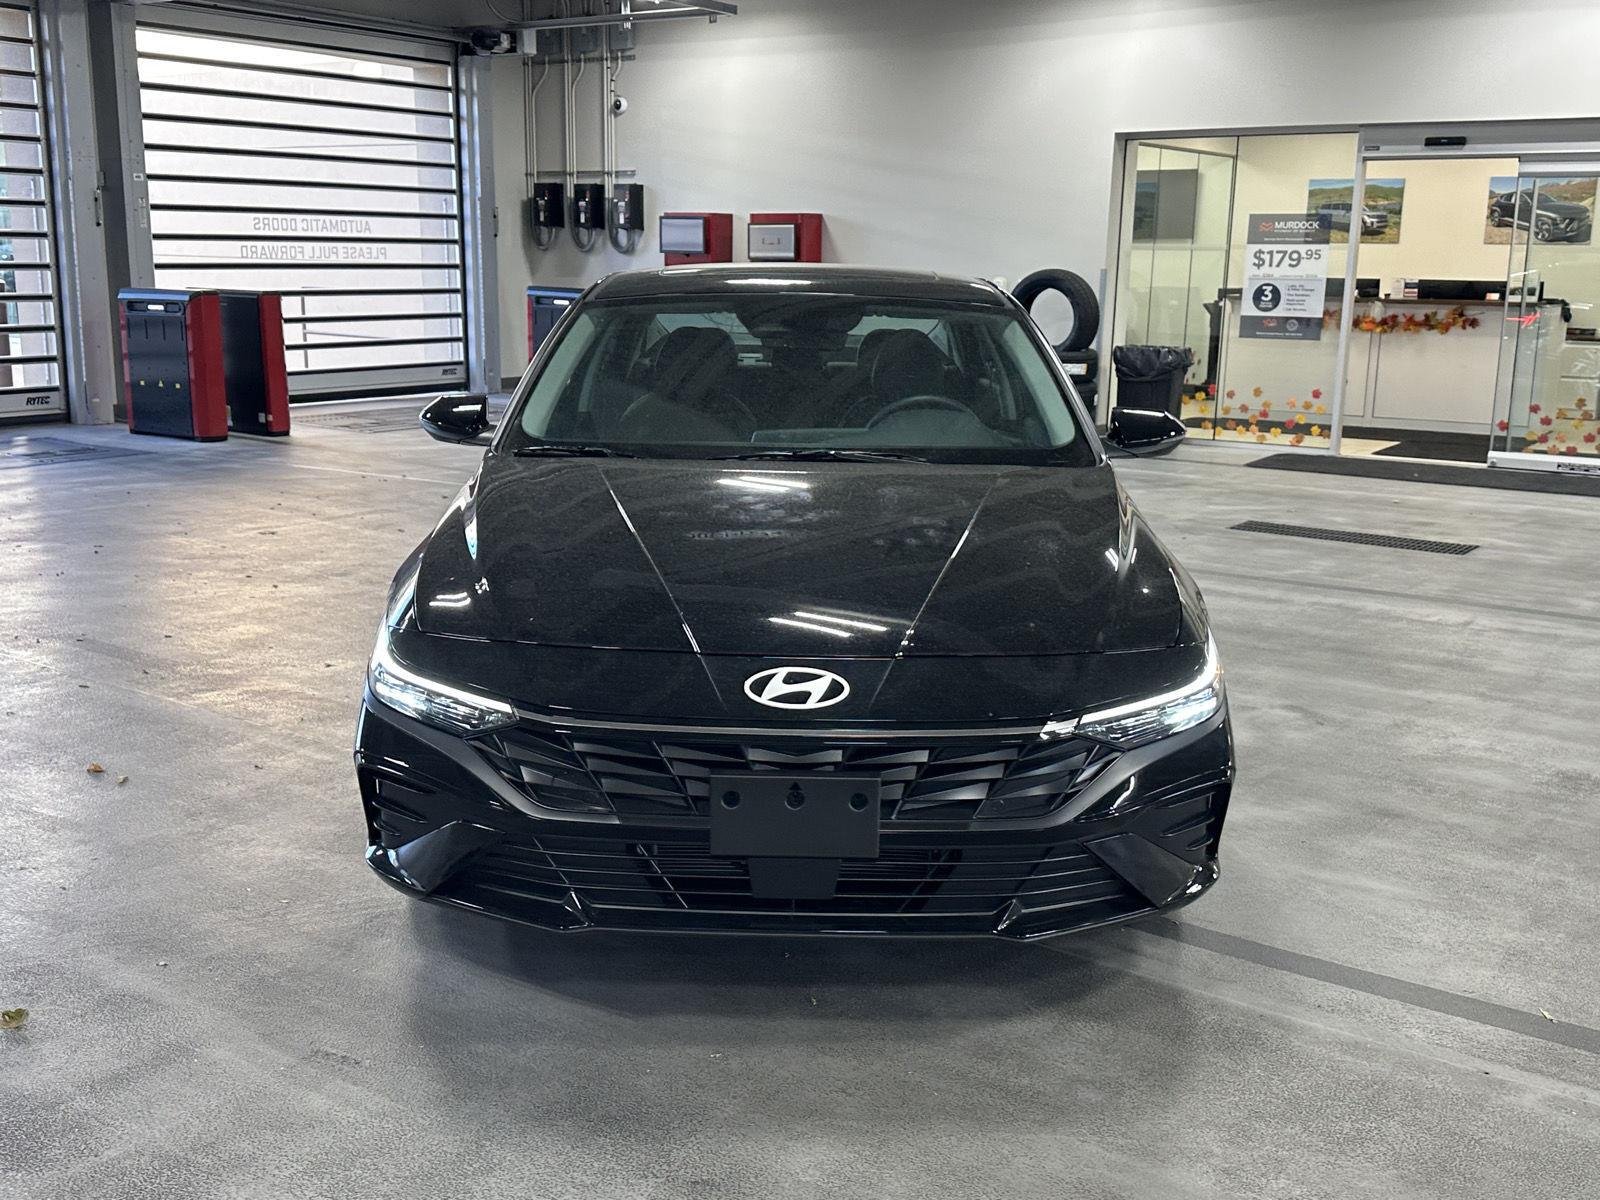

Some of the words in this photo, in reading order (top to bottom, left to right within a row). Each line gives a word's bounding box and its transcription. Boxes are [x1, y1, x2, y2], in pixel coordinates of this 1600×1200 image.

[1274, 221, 1320, 229] MURDOCK
[1261, 285, 1273, 301] 3
[26, 395, 51, 406] RYTEC
